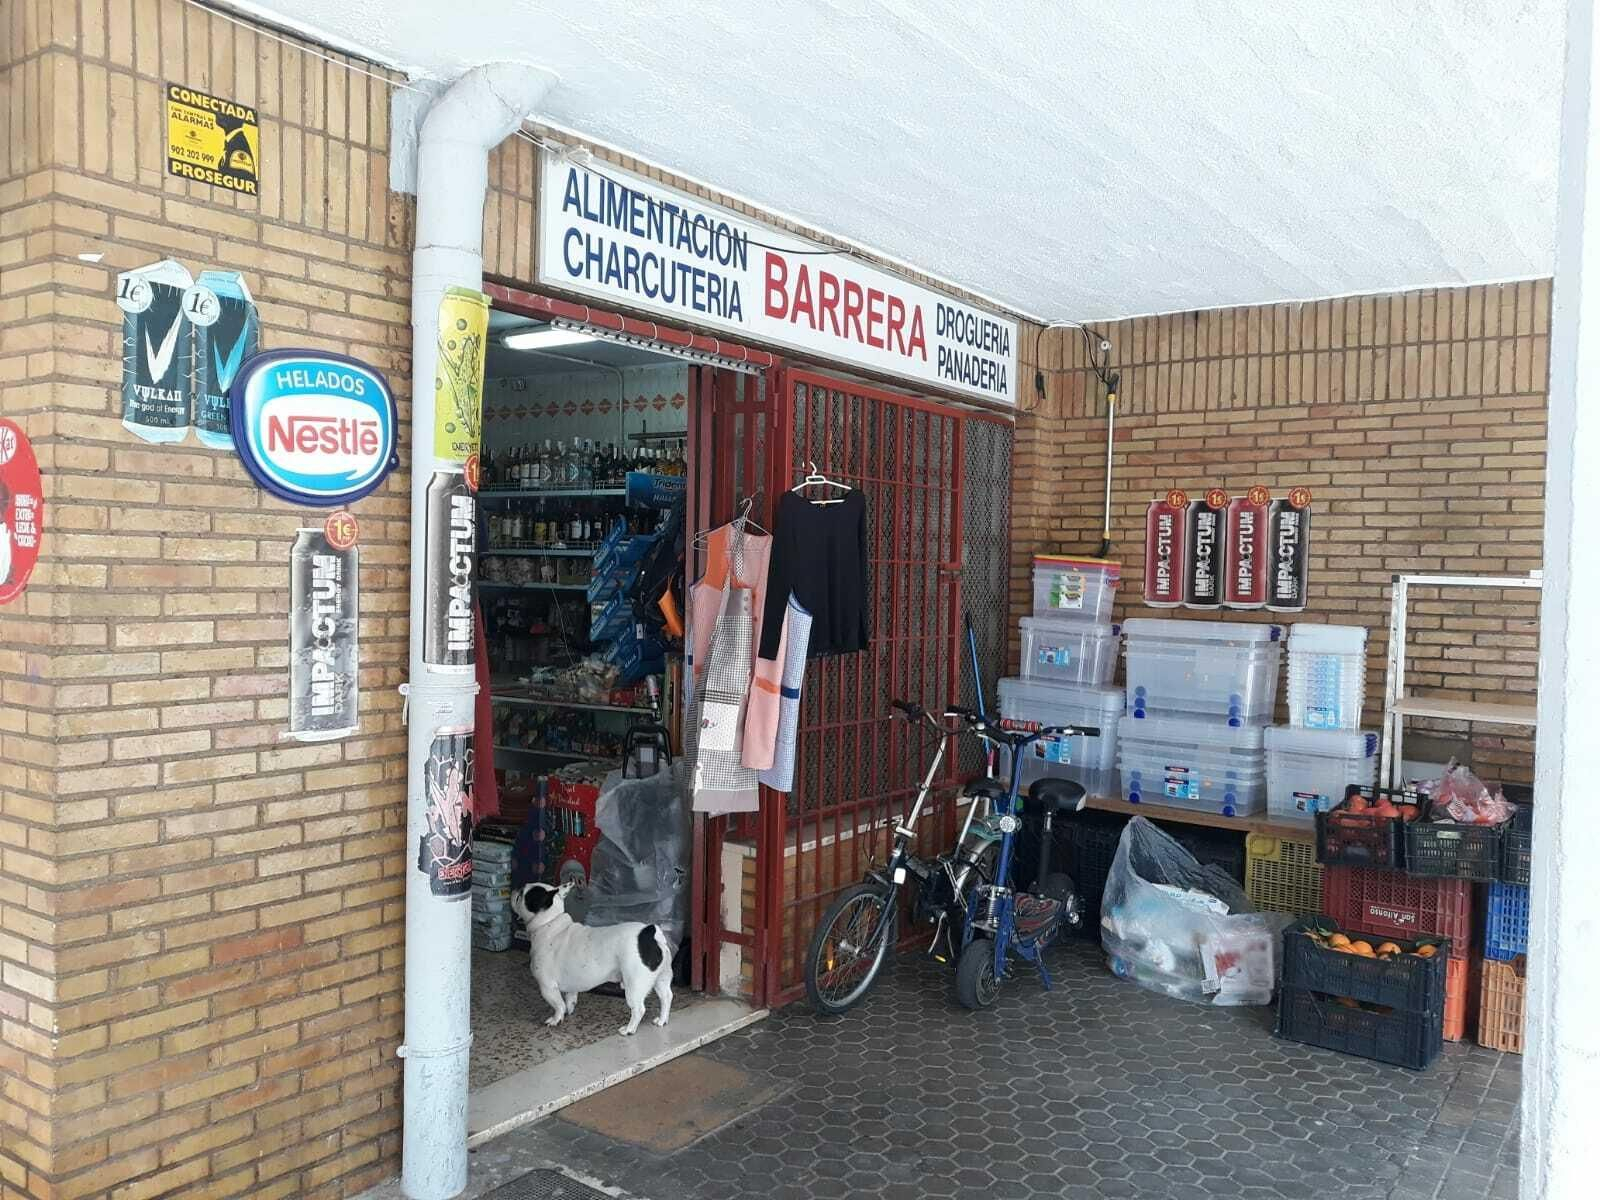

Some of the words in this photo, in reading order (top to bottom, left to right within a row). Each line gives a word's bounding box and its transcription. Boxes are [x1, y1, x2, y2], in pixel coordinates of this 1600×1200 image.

[170, 86, 256, 123] CONECTADA
[171, 111, 215, 130] ALARMAS
[171, 144, 185, 156] 902
[202, 153, 215, 163] 999
[171, 161, 257, 194] PROSEGUR
[562, 166, 748, 272] ALIMENTACION
[118, 278, 144, 300] 1€
[562, 227, 743, 323] CHARCUTERIA
[188, 292, 213, 316] 1€
[764, 251, 928, 362] BARRERA
[936, 302, 1011, 358] DROGUERIA
[276, 370, 365, 396] HELADOS
[937, 345, 1008, 395] PANADERIA
[268, 415, 379, 455] Nestlé
[333, 518, 351, 541] 1€
[1156, 514, 1172, 595] IMPACTUM
[1194, 511, 1213, 597] IMPACTUM
[1238, 511, 1254, 596] IMPACTUM
[447, 494, 473, 651] IMPACTUM
[1276, 511, 1296, 599] IMPACTUM
[311, 554, 336, 717] IMPACTUM
[1369, 906, 1399, 919] Alfonso
